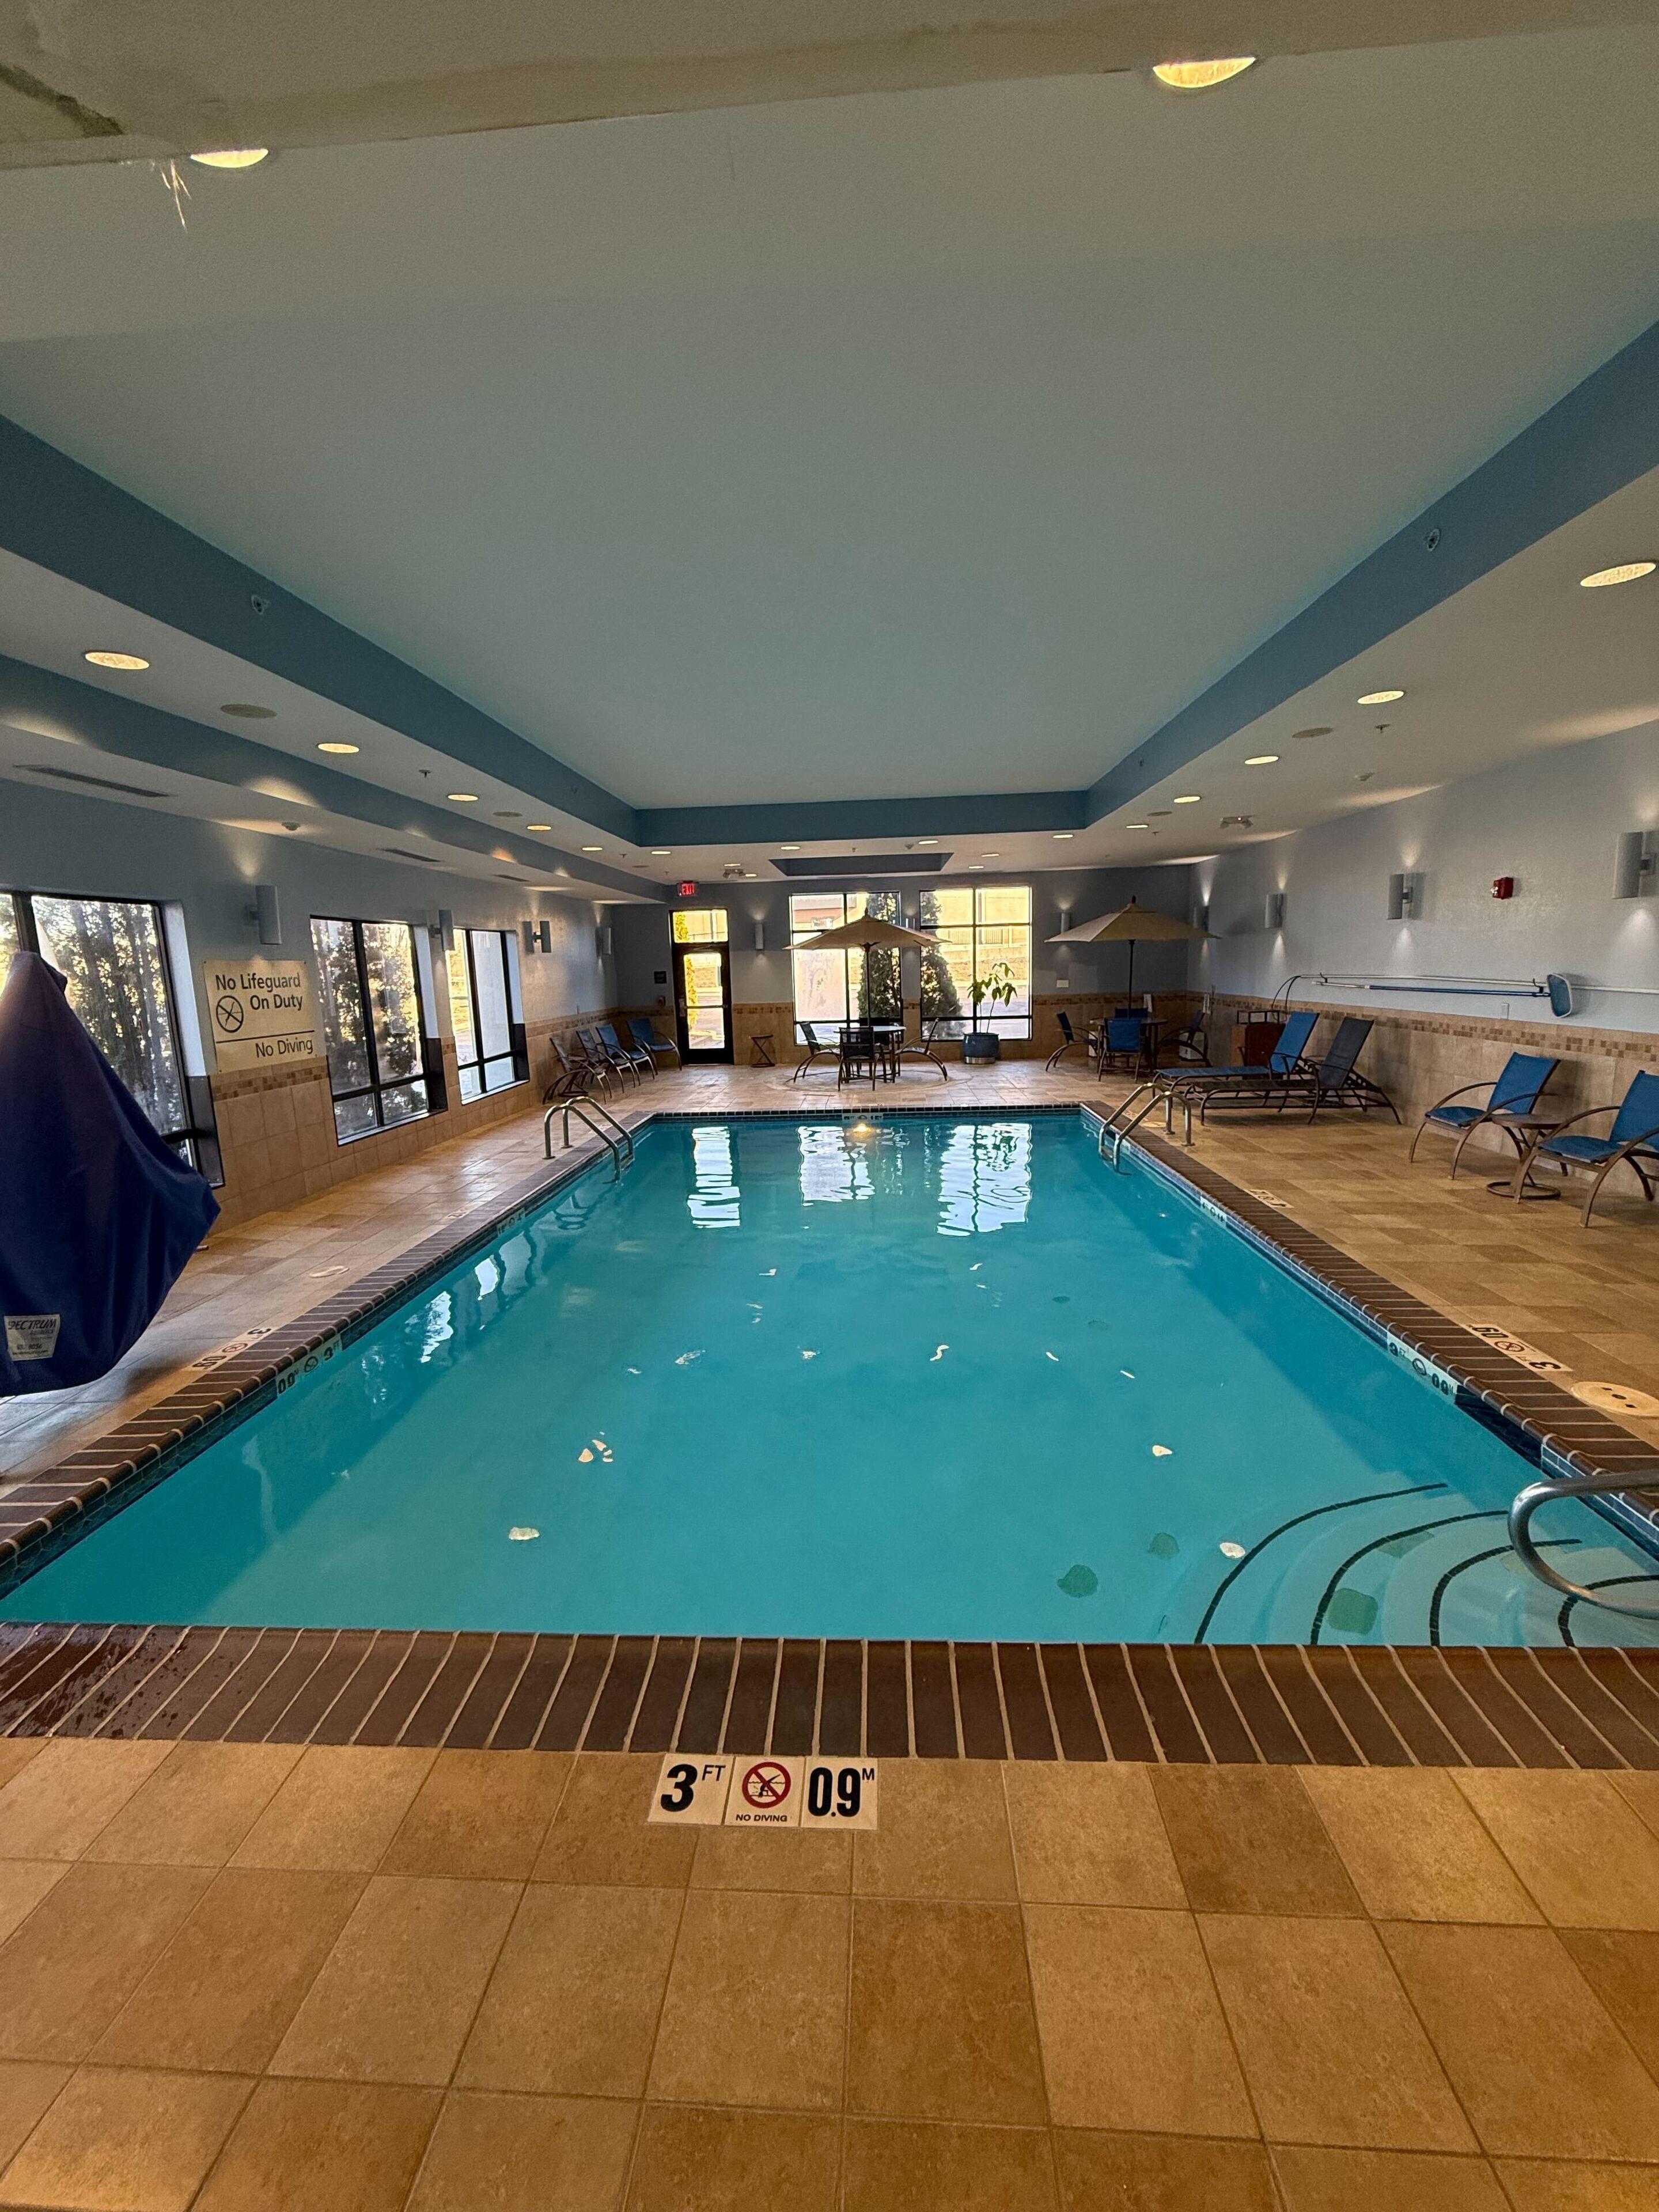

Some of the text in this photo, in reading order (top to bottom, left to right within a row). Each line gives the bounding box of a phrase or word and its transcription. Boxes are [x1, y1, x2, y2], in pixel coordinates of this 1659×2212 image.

[681, 883, 695, 895] EXIT
[215, 972, 301, 993] No Lifeguard
[250, 994, 303, 1011] On Duty
[255, 1037, 313, 1058] No Diving
[1529, 1361, 1562, 1369] 3
[660, 1764, 726, 1812] 3 FT
[753, 1814, 787, 1822] DIVING
